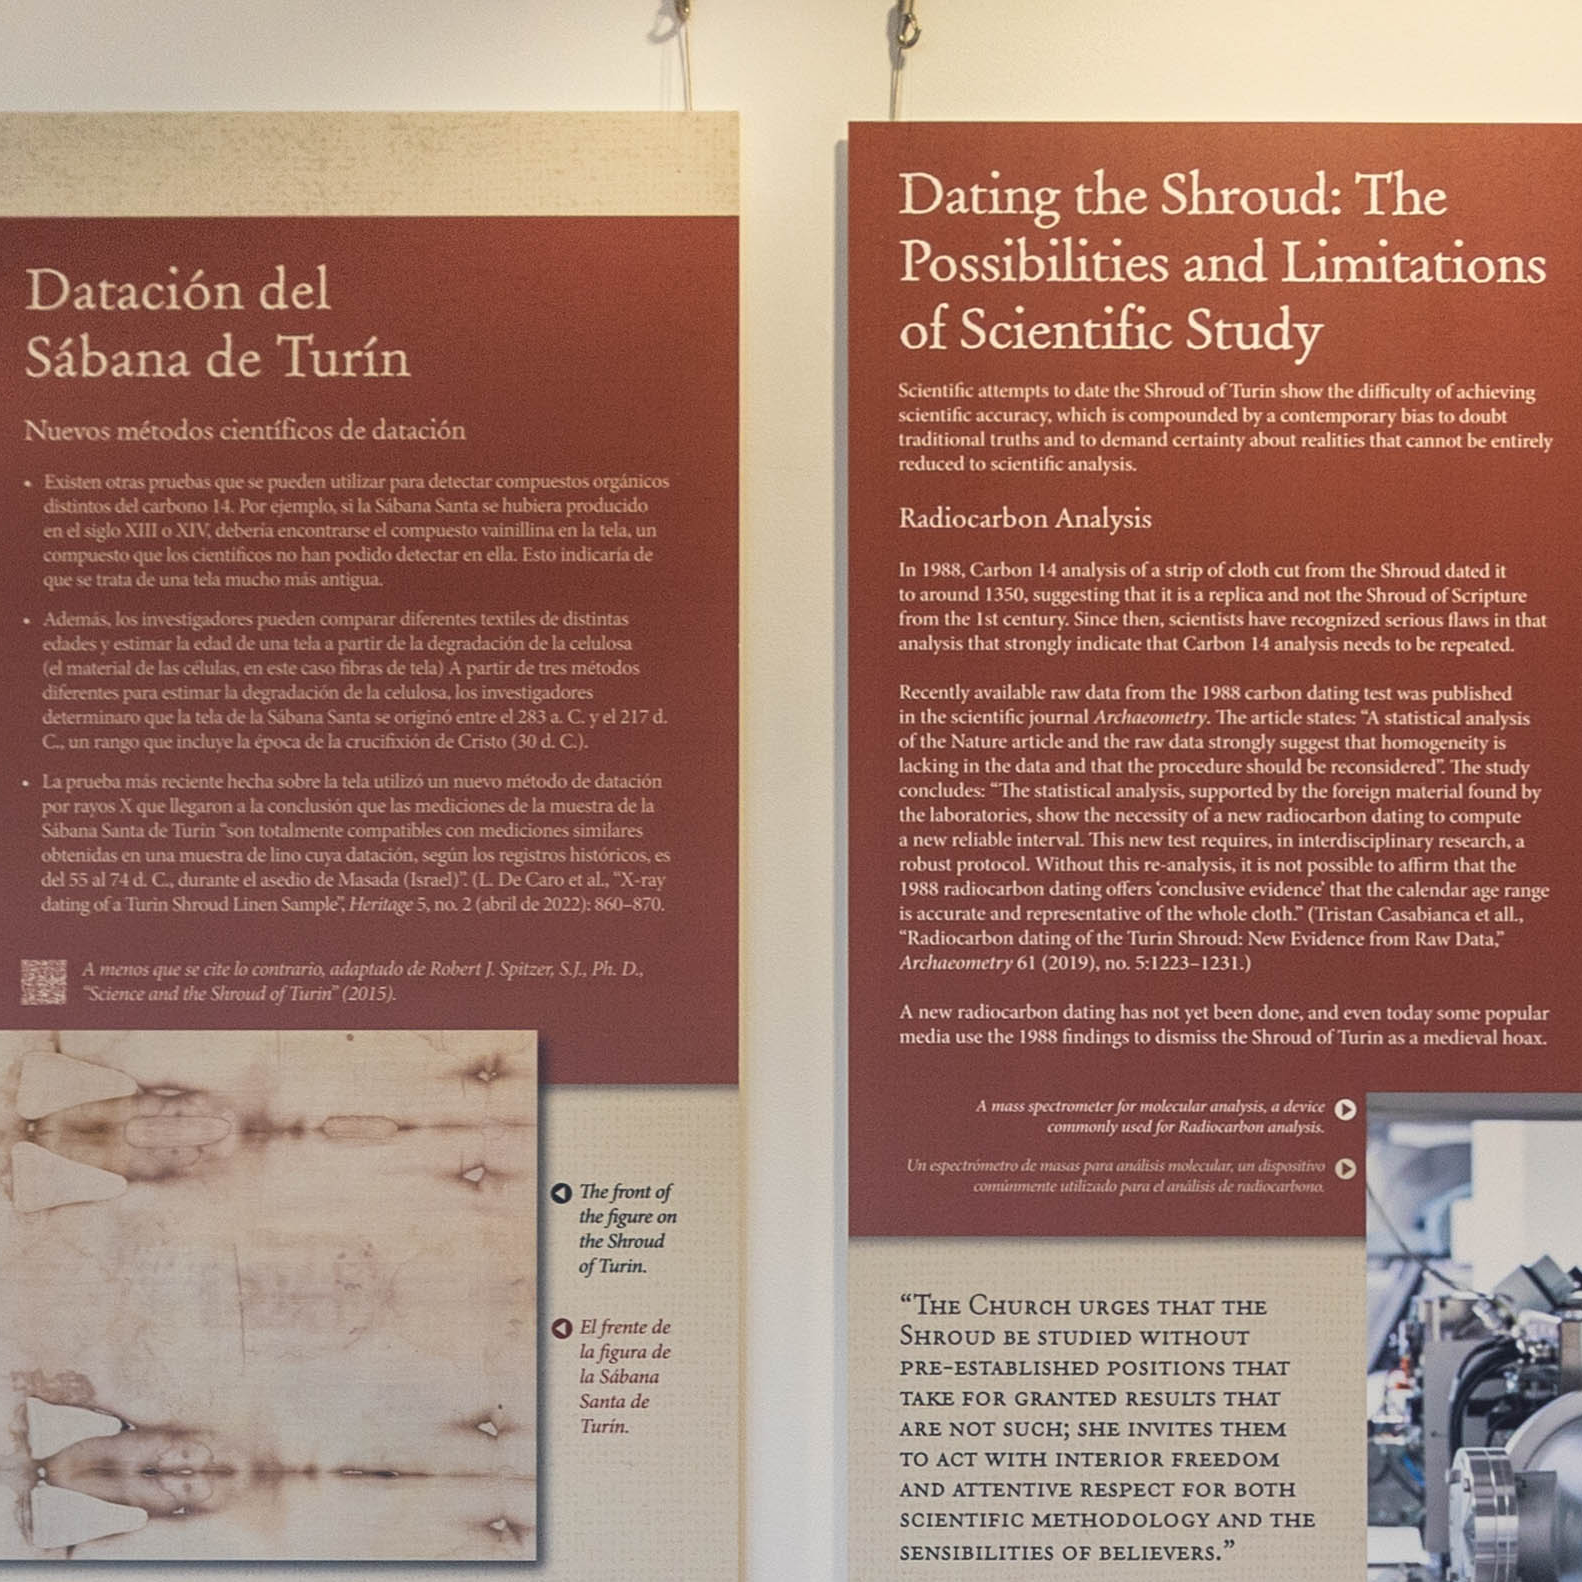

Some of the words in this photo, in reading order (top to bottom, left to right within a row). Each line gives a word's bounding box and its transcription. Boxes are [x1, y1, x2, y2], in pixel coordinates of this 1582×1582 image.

[899, 171, 1061, 229] Dating
[1075, 169, 1147, 215] the
[1162, 169, 1341, 215] Shroud:
[1355, 169, 1447, 215] The
[900, 237, 1169, 282] Possibilities
[1184, 238, 1267, 282] and
[1282, 239, 1546, 283] Limitations
[26, 266, 244, 310] Datación
[260, 264, 330, 310] del
[900, 303, 949, 349] of
[961, 303, 1172, 350] Scientific
[1187, 305, 1324, 365] Study
[26, 333, 190, 378] Sábana
[207, 333, 260, 377] de
[277, 334, 411, 377] Turín
[25, 419, 110, 440] Nuevos
[117, 418, 213, 440] métodos
[220, 417, 333, 440] científicos
[340, 417, 366, 440] de
[372, 418, 466, 440] datación
[899, 455, 964, 471] reduced
[970, 458, 986, 471] to
[991, 455, 1063, 471] scientific
[1068, 456, 1136, 476] analysis.
[900, 506, 1048, 528] Radiocarbon
[1055, 506, 1152, 535] Analysis
[976, 1100, 986, 1112] A
[992, 1103, 1025, 1112] mass
[1028, 1099, 1113, 1116] spectrometer
[1114, 1099, 1137, 1116] for
[1140, 1099, 1207, 1112] molecular
[1210, 1099, 1267, 1116] analysis,
[1271, 1104, 1280, 1112] a
[1283, 1099, 1325, 1112] device
[1047, 1120, 1118, 1136] commonly
[1122, 1120, 1153, 1133] used
[1153, 1120, 1175, 1137] for
[1179, 1120, 1264, 1133] Radiocarbon
[1268, 1120, 1324, 1137] analysis.
[580, 1183, 608, 1199] The
[610, 1183, 651, 1204] front
[655, 1183, 674, 1204] of
[580, 1208, 603, 1223] the
[605, 1208, 653, 1228] figure
[657, 1213, 677, 1224] on
[580, 1233, 604, 1248] the
[607, 1233, 665, 1248] Shroud
[579, 1257, 597, 1278] of
[599, 1258, 646, 1273] Turin.
[580, 1319, 597, 1334] El
[597, 1319, 647, 1339] frente
[652, 1318, 671, 1334] de
[580, 1344, 594, 1359] la
[596, 1343, 646, 1364] figura
[652, 1343, 671, 1359] de
[580, 1368, 594, 1383] la
[599, 1368, 659, 1384] Sábana
[579, 1394, 625, 1408] Santa
[630, 1393, 650, 1408] de
[581, 1419, 629, 1433] Turín.
